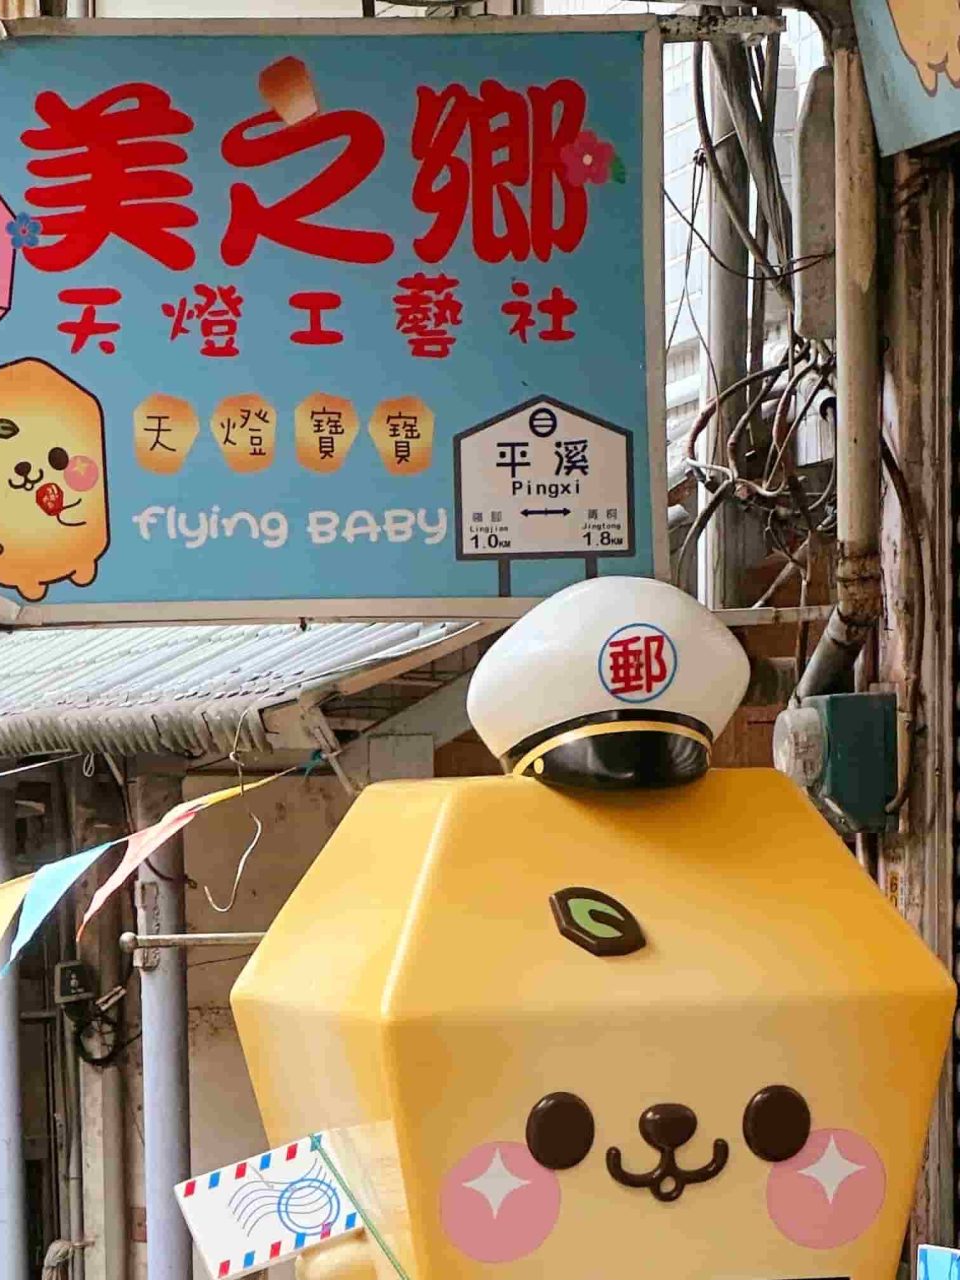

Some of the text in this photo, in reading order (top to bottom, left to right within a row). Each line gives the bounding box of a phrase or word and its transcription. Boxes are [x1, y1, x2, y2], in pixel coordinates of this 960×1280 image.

[20, 79, 588, 272] 美之鄉
[57, 272, 578, 358] 天燈工藝社
[143, 406, 421, 465] 天燈寶寶
[496, 439, 589, 478] 平溪
[512, 480, 580, 498] Pingxi
[132, 504, 448, 548] flying BABY
[609, 635, 666, 695] 郵
